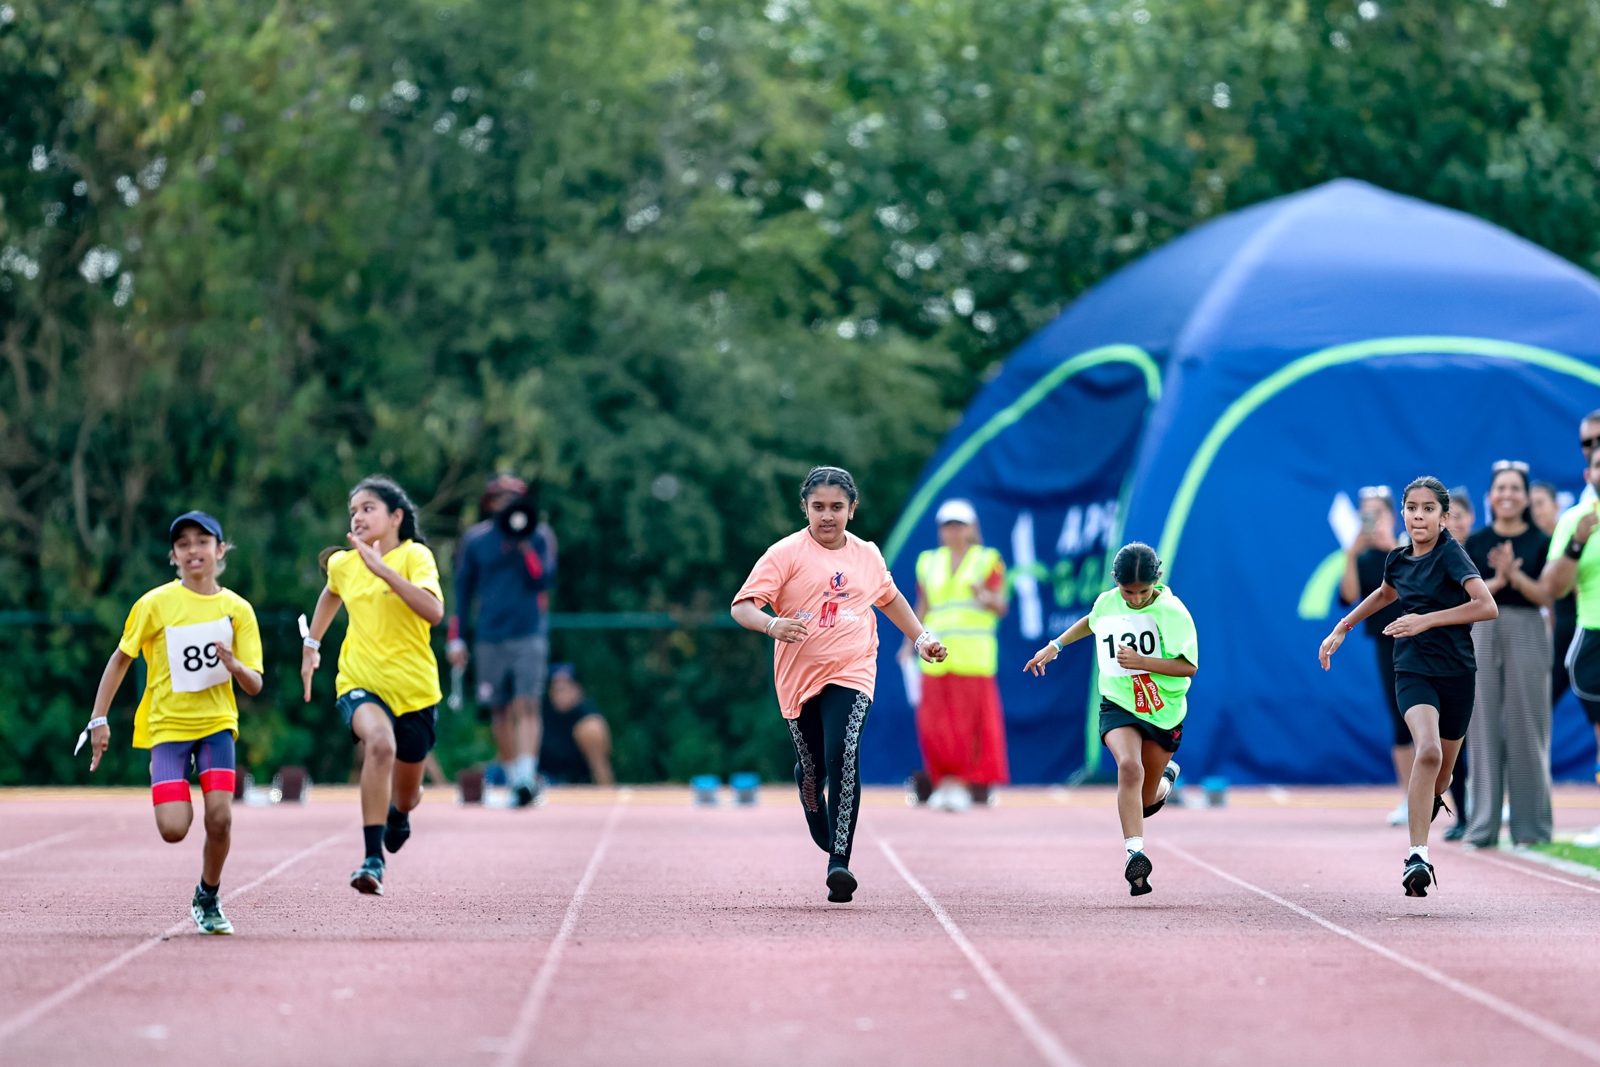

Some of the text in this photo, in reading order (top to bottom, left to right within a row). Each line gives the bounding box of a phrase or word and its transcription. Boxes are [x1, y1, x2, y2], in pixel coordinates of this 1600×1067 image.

[183, 642, 220, 672] 89
[1103, 630, 1156, 659] 130
[1137, 691, 1145, 708] Sikh
[1146, 681, 1161, 707] Council
